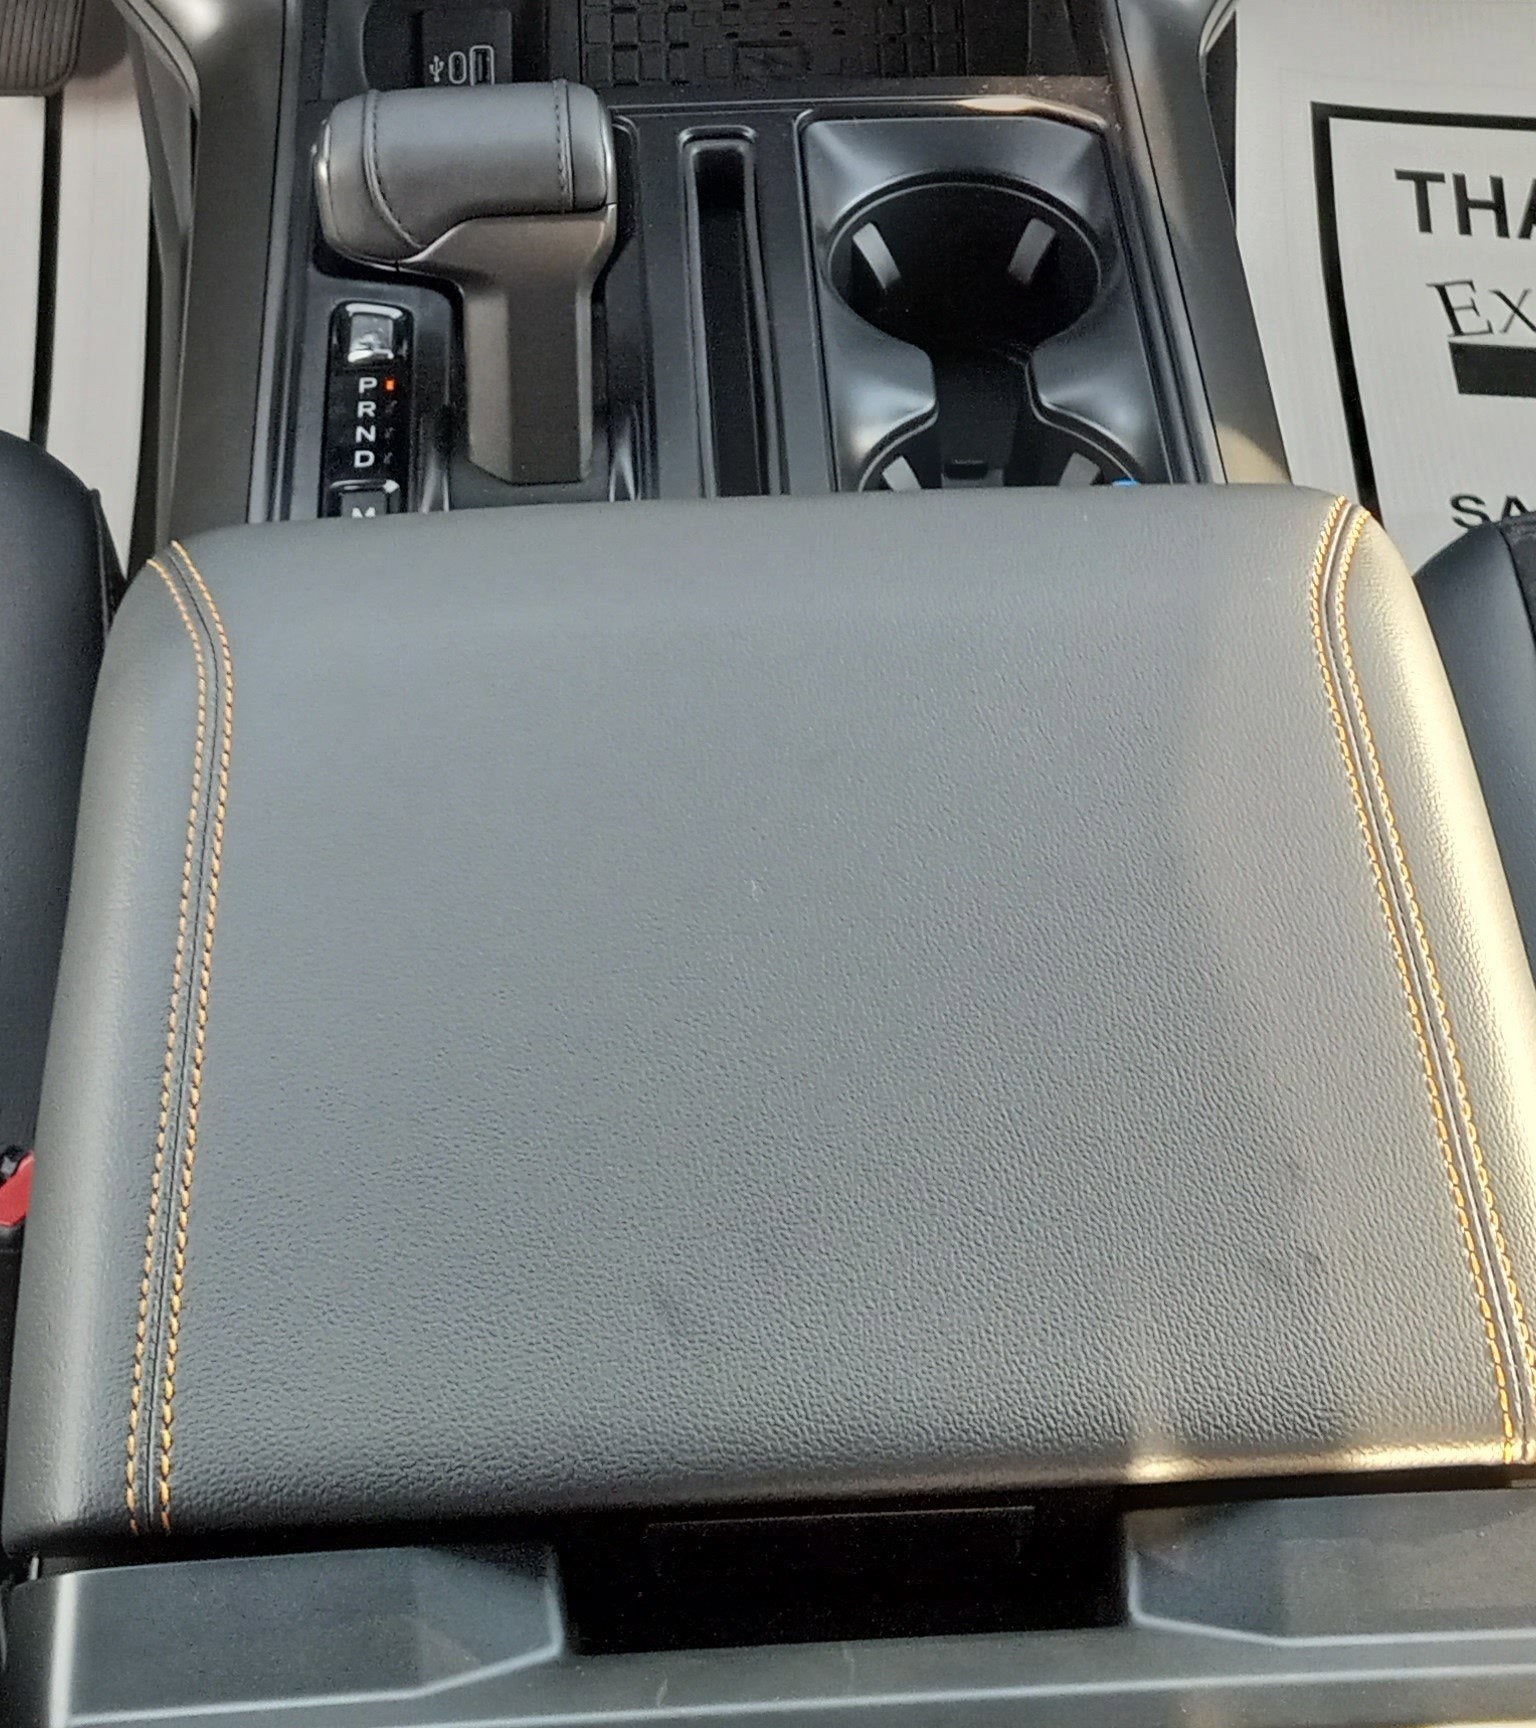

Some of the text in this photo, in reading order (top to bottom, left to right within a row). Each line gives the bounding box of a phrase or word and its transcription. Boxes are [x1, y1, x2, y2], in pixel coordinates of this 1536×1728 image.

[359, 377, 378, 394] P
[357, 401, 377, 418] R
[355, 425, 376, 443] N
[353, 450, 375, 468] D
